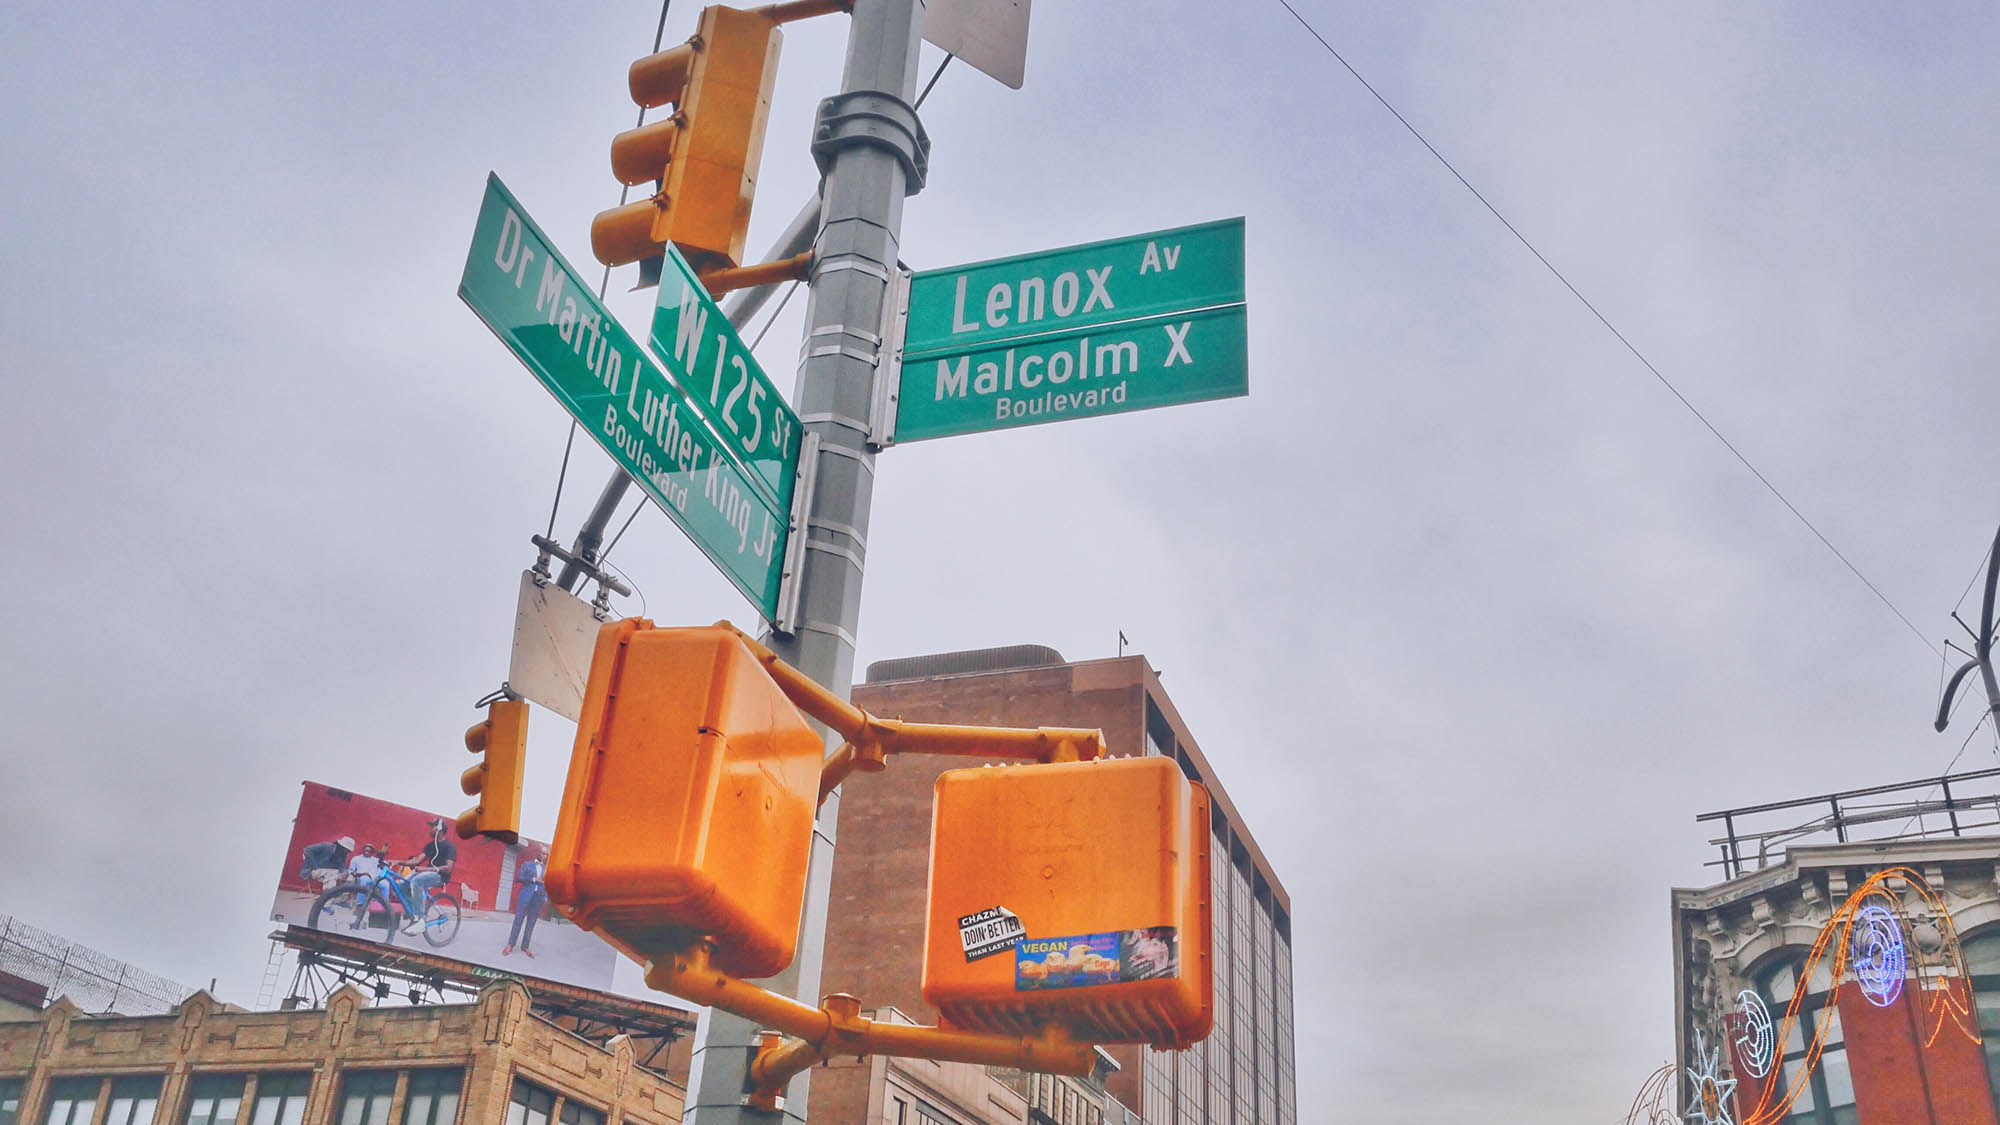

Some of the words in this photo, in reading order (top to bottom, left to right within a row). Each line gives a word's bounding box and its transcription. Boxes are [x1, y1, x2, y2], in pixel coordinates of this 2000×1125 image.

[952, 265, 1115, 334] Lenox
[1139, 241, 1181, 275] Av
[494, 207, 534, 290] Dr
[535, 262, 622, 395] Martin
[626, 358, 702, 483] Luther
[704, 454, 752, 553] King
[753, 508, 778, 567] Jr
[673, 280, 708, 377] W
[709, 334, 768, 454] 125
[771, 405, 792, 460] St
[935, 336, 1139, 401] Malcolm
[1163, 321, 1193, 367] X
[996, 380, 1127, 420] Boulevard
[603, 403, 689, 514] Boulevard
[968, 947, 988, 958] THAN
[988, 941, 1005, 952] LAST
[987, 919, 1021, 939] BETTER
[1022, 941, 1068, 953] VEGAN
